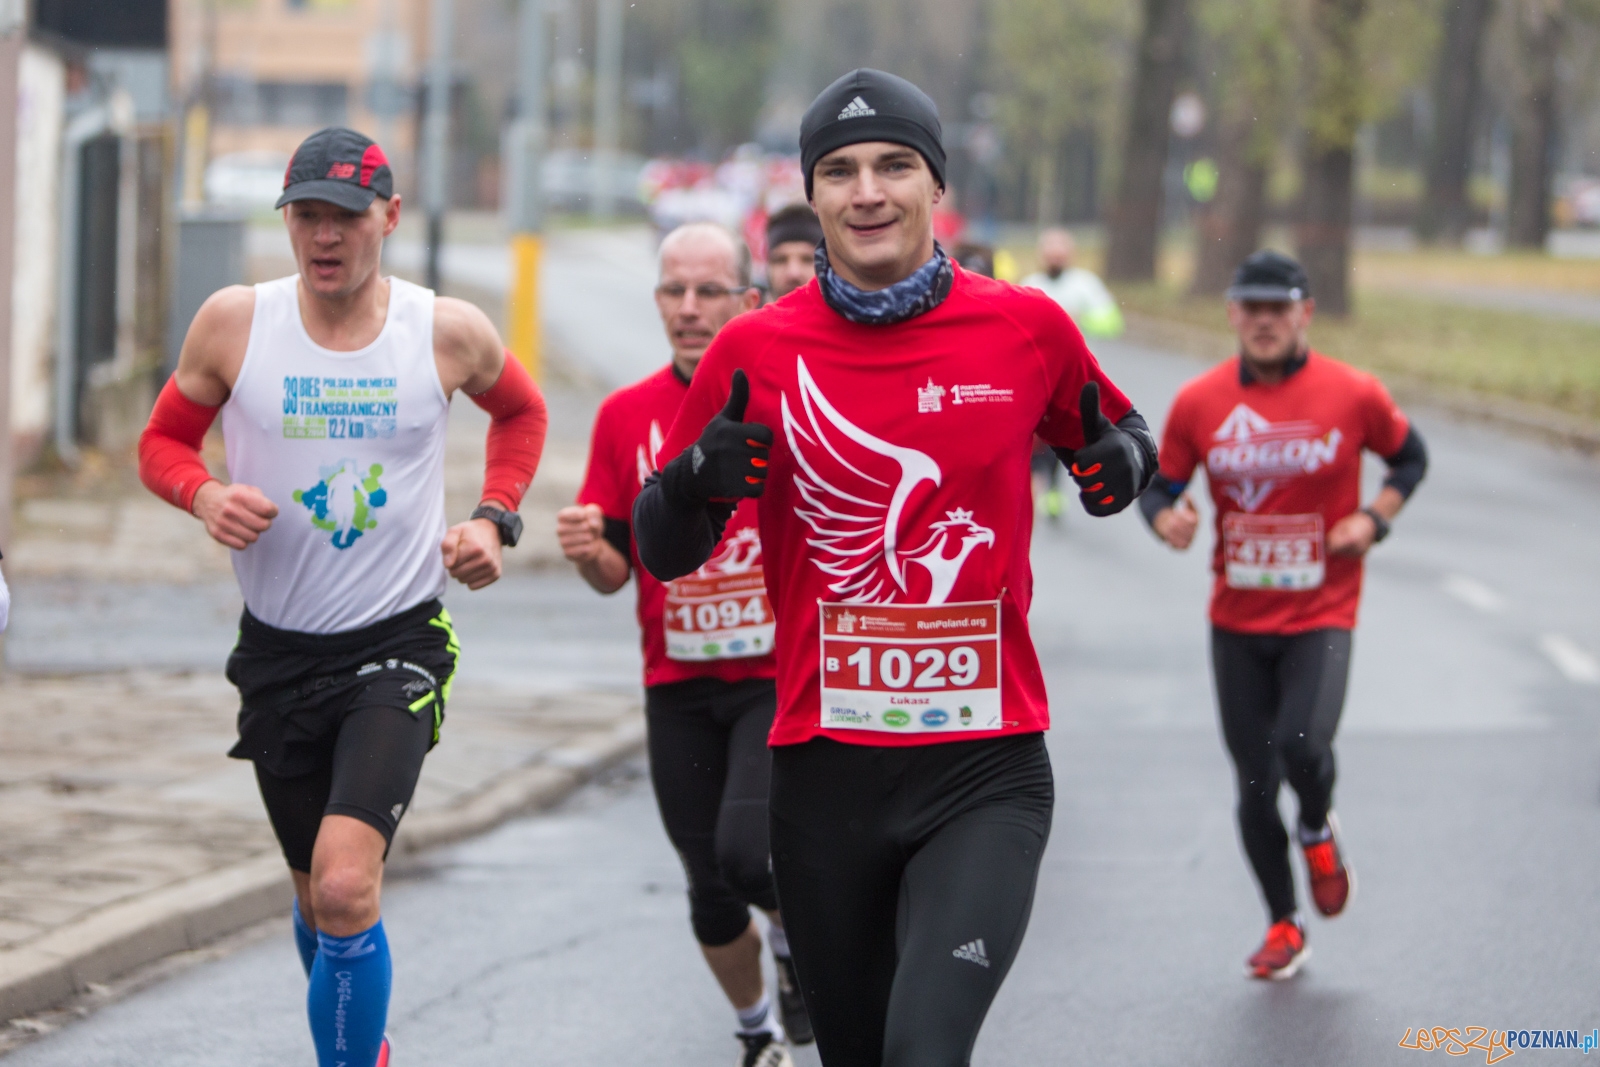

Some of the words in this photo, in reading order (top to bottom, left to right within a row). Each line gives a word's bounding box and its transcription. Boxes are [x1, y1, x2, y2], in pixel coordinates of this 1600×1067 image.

[837, 108, 876, 121] adidas
[283, 375, 298, 415] 39
[299, 376, 320, 398] BIEG
[950, 384, 964, 405] 1
[300, 401, 398, 416] TRANSGRANICZNY
[348, 418, 364, 439] km
[677, 595, 766, 631] 1094
[916, 617, 988, 630] RunPoland.org
[826, 657, 840, 672] B
[847, 646, 981, 689] 1029
[952, 948, 990, 968] adidas
